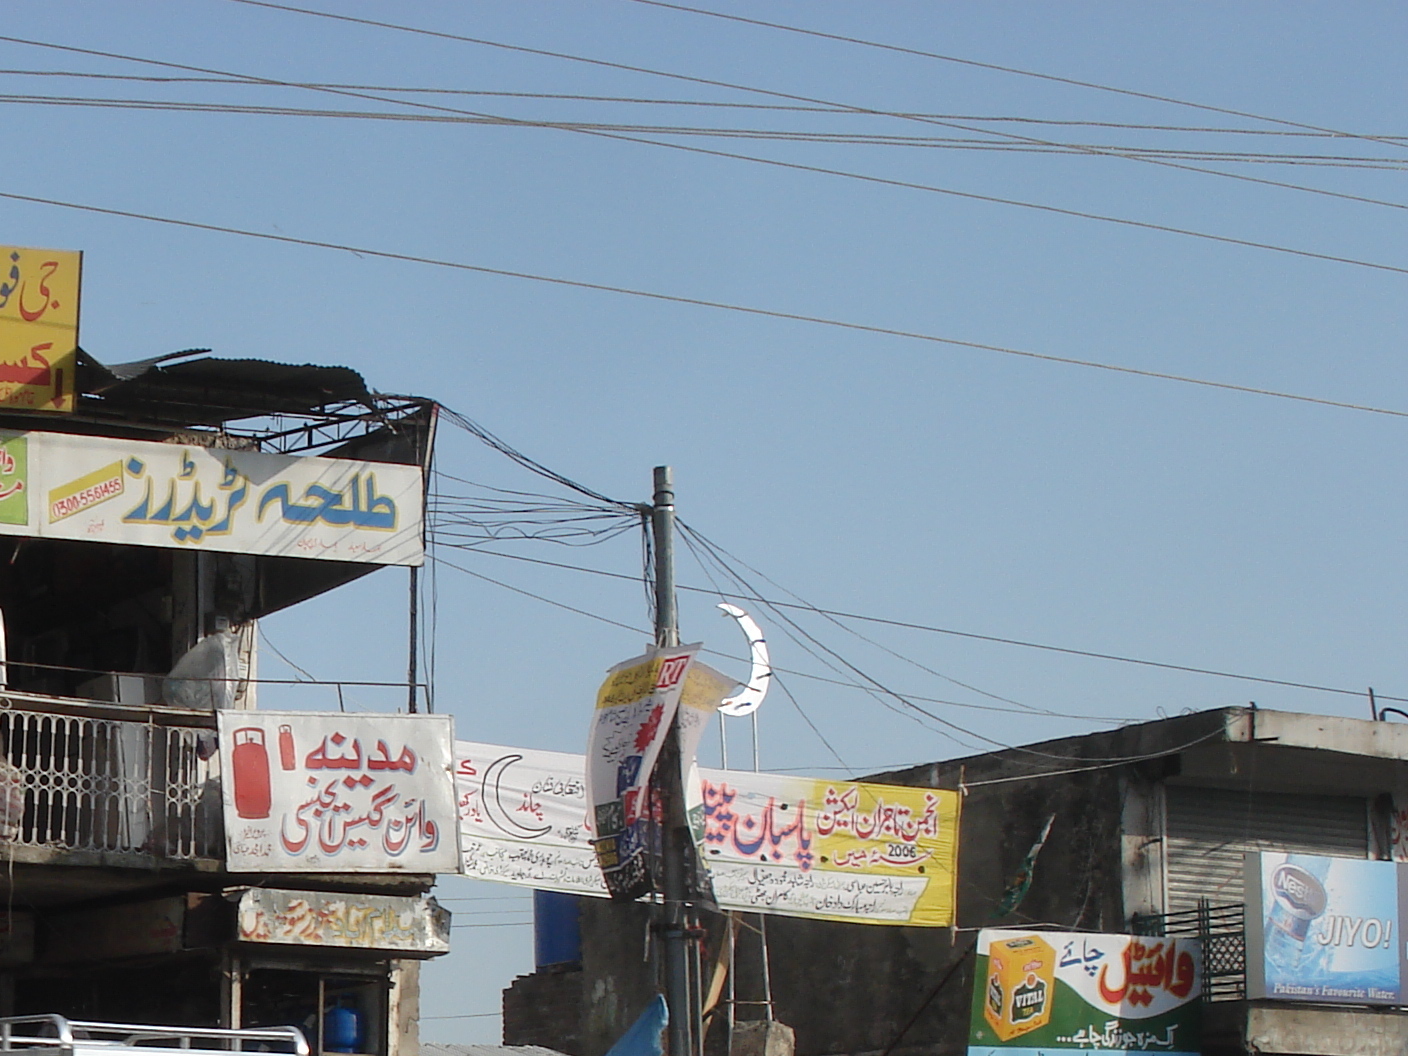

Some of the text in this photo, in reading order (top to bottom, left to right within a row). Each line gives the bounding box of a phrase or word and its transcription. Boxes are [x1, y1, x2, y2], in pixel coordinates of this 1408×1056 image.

[19, 260, 60, 322] جی
[120, 449, 399, 545] طلحہ ٹریڈرز
[305, 732, 417, 788] مدینہ
[319, 784, 398, 853] گیس
[516, 792, 543, 821] چاند
[817, 787, 940, 841] انجمن تاجران الیکشن
[733, 797, 813, 871] پاسبان
[888, 844, 917, 858] 2006
[1316, 915, 1392, 950] JIYO!
[1059, 937, 1105, 977] چائے
[1016, 990, 1045, 1008] VITAL
[1273, 982, 1320, 996] Pakistan's
[1322, 984, 1365, 998] Favourite
